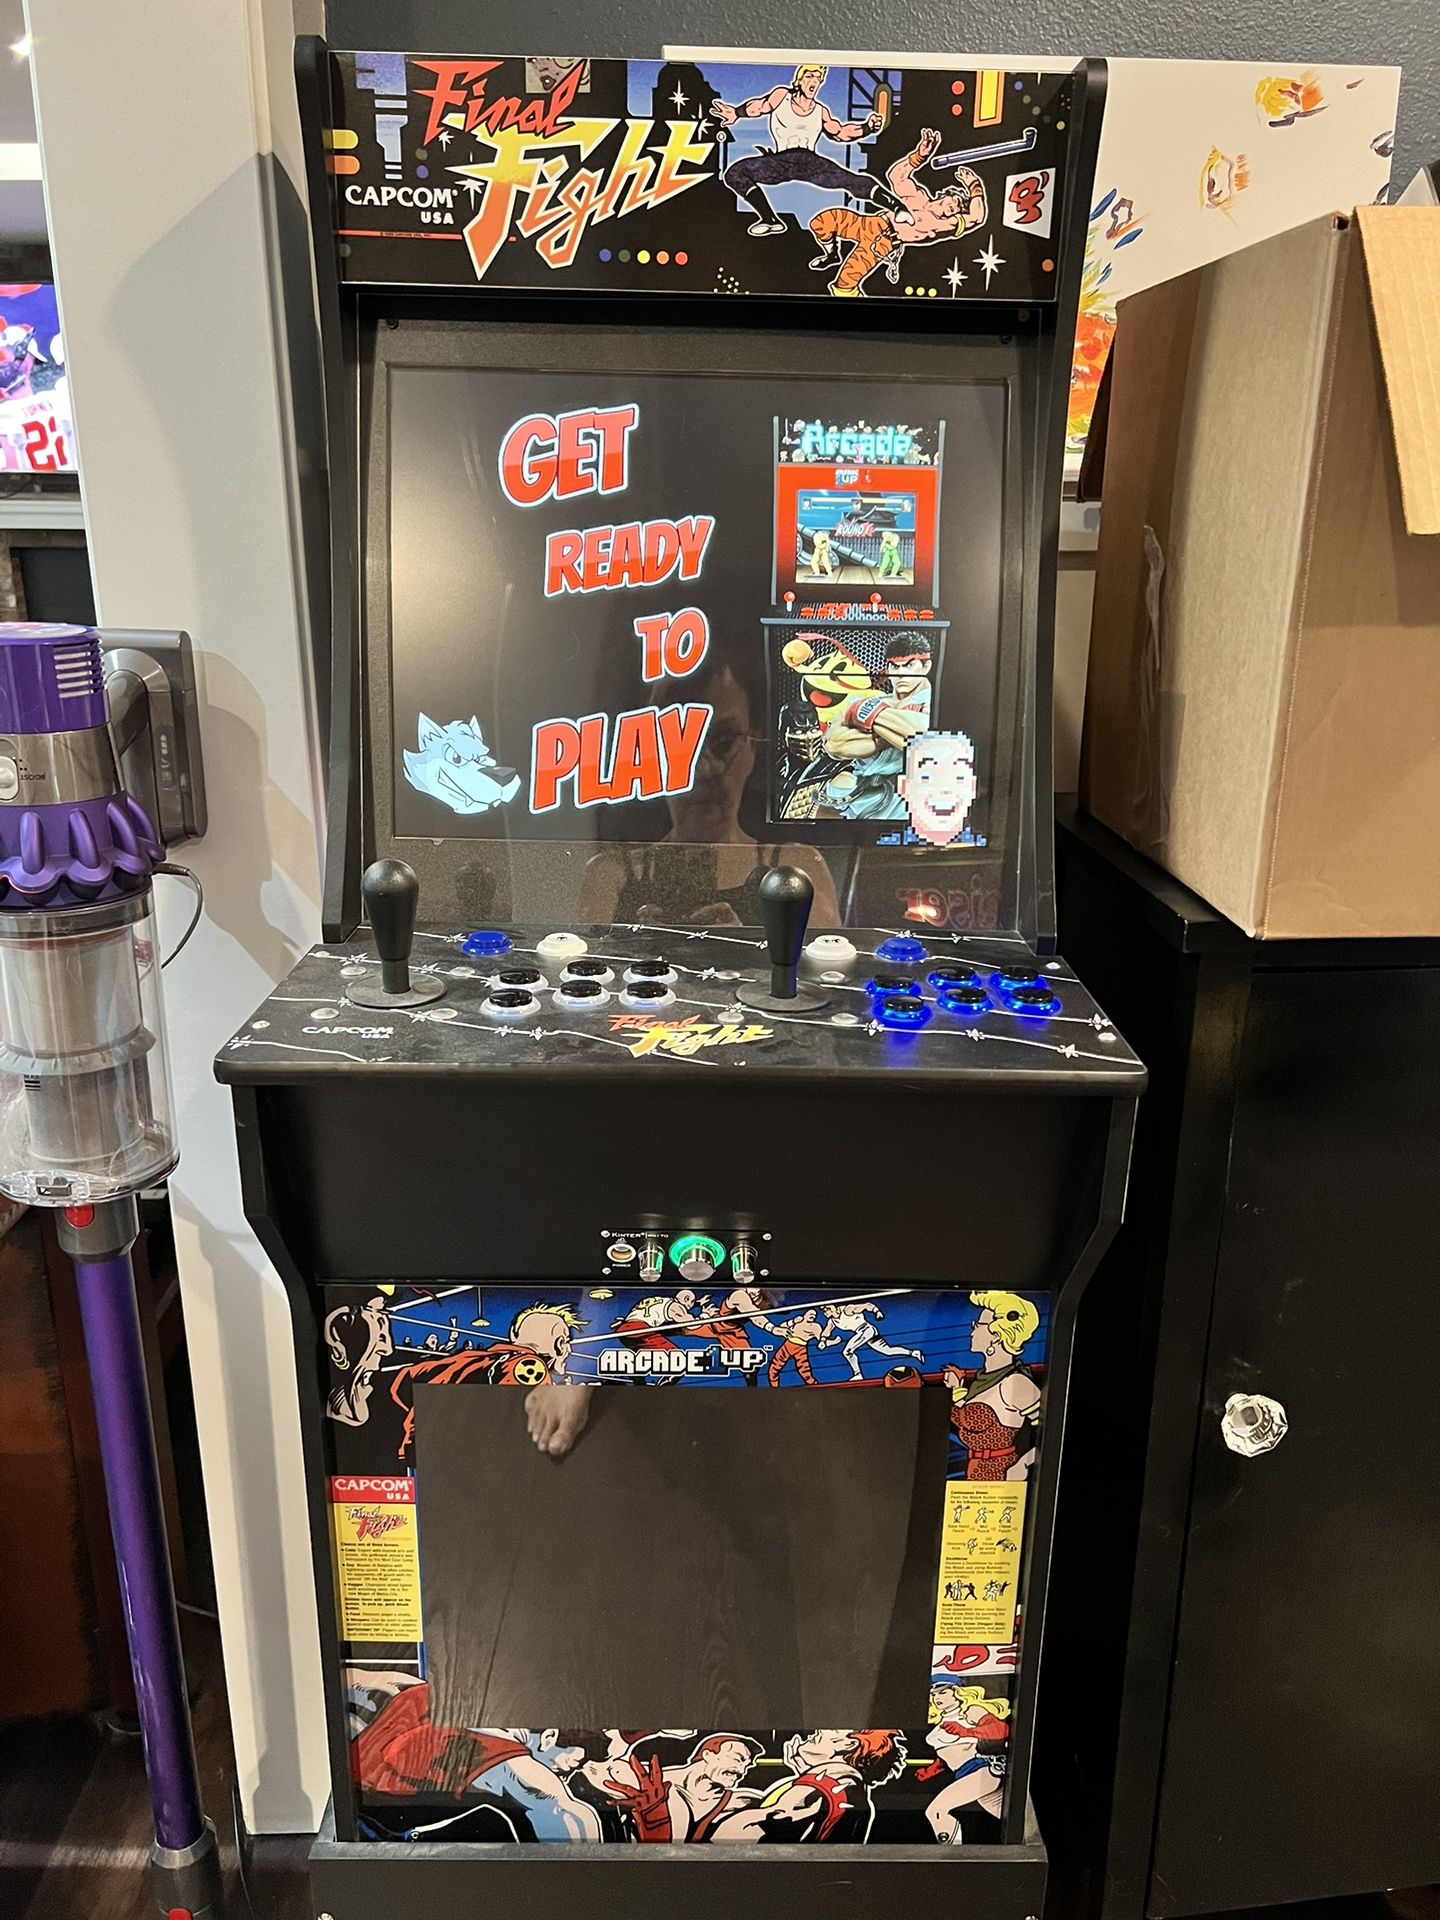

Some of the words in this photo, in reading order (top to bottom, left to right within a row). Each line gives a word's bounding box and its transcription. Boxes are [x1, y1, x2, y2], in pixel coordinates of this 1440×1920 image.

[411, 58, 588, 146] Final
[345, 185, 454, 208] CAPCOM
[443, 115, 716, 281] Fight
[421, 211, 454, 224] USA
[499, 404, 639, 507] GET
[545, 516, 714, 597] READY
[634, 607, 709, 682] TO
[529, 703, 713, 814] PLAY
[301, 1026, 394, 1035] CAPCOM
[607, 1014, 701, 1032] Final
[620, 1024, 775, 1059] Fight
[334, 1478, 409, 1491] CAPCOM
[386, 1492, 410, 1500] USA
